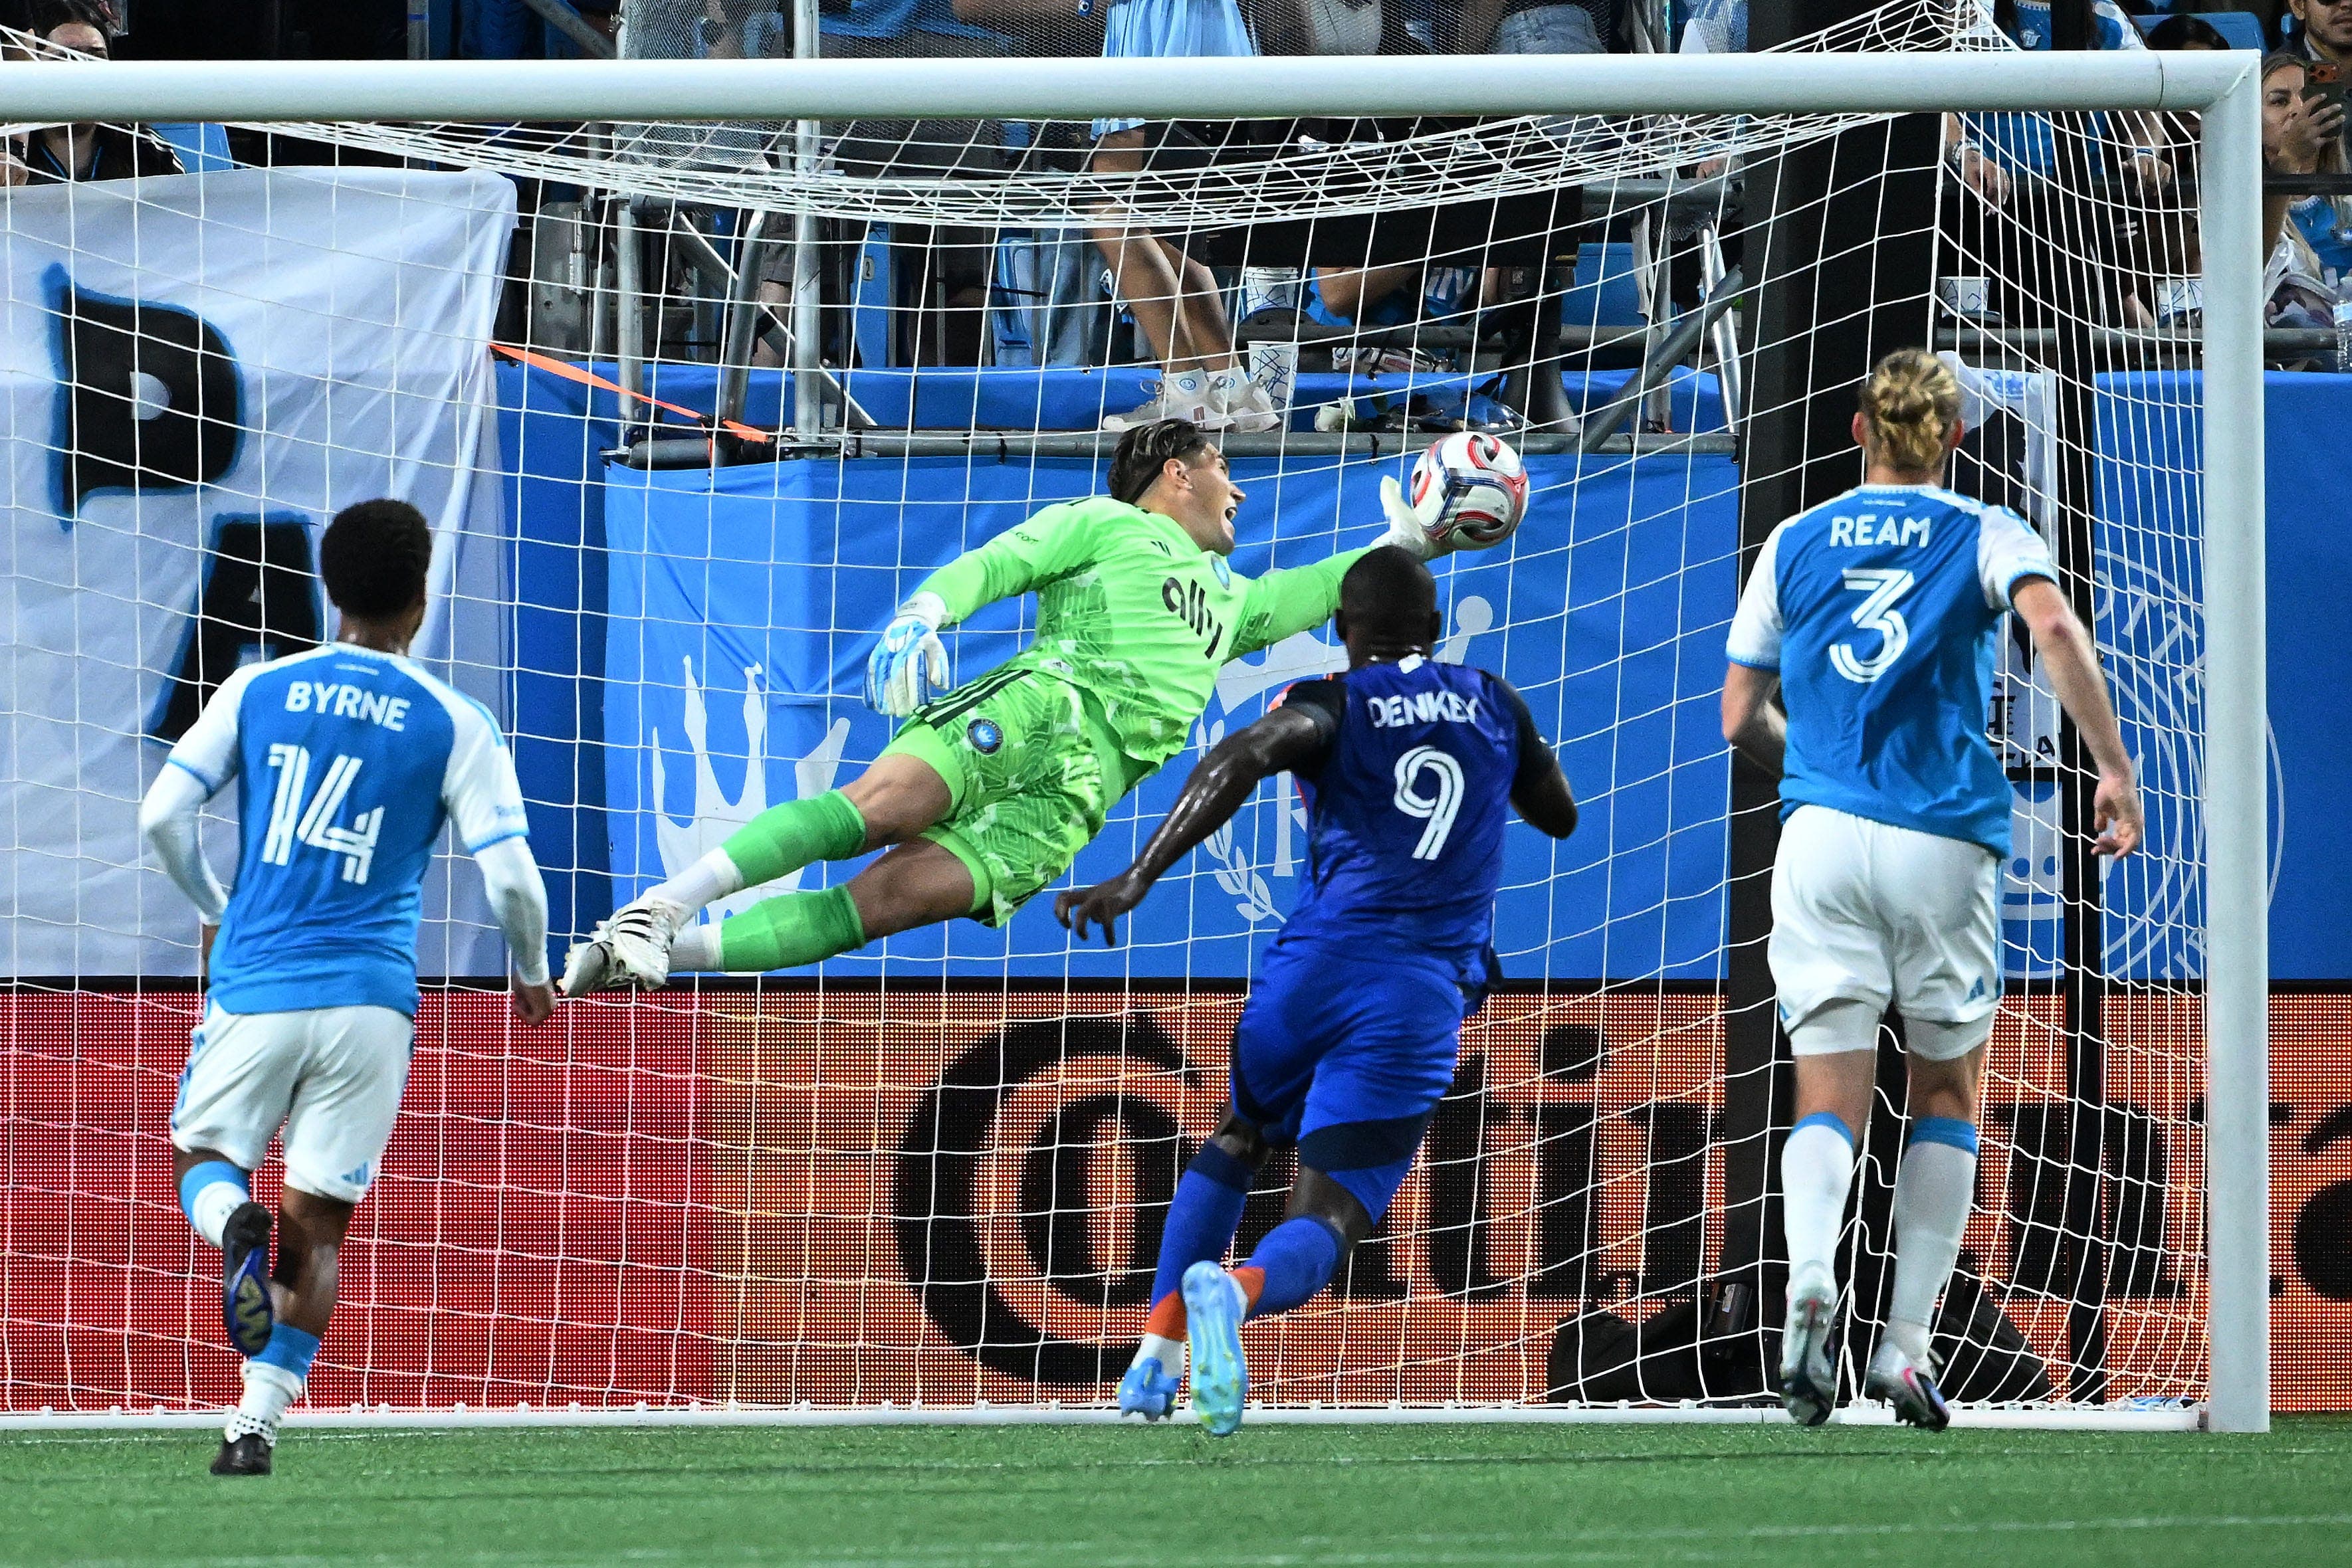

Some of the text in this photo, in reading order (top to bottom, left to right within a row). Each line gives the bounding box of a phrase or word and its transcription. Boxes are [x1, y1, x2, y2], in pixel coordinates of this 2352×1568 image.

[1830, 514, 1931, 548] REAM
[1162, 577, 1224, 660] ally
[1829, 568, 1914, 684] 3
[284, 680, 411, 732] BYRNE
[1368, 690, 1479, 728] DENKEY
[261, 742, 385, 886] 14
[1393, 744, 1465, 860] 9
